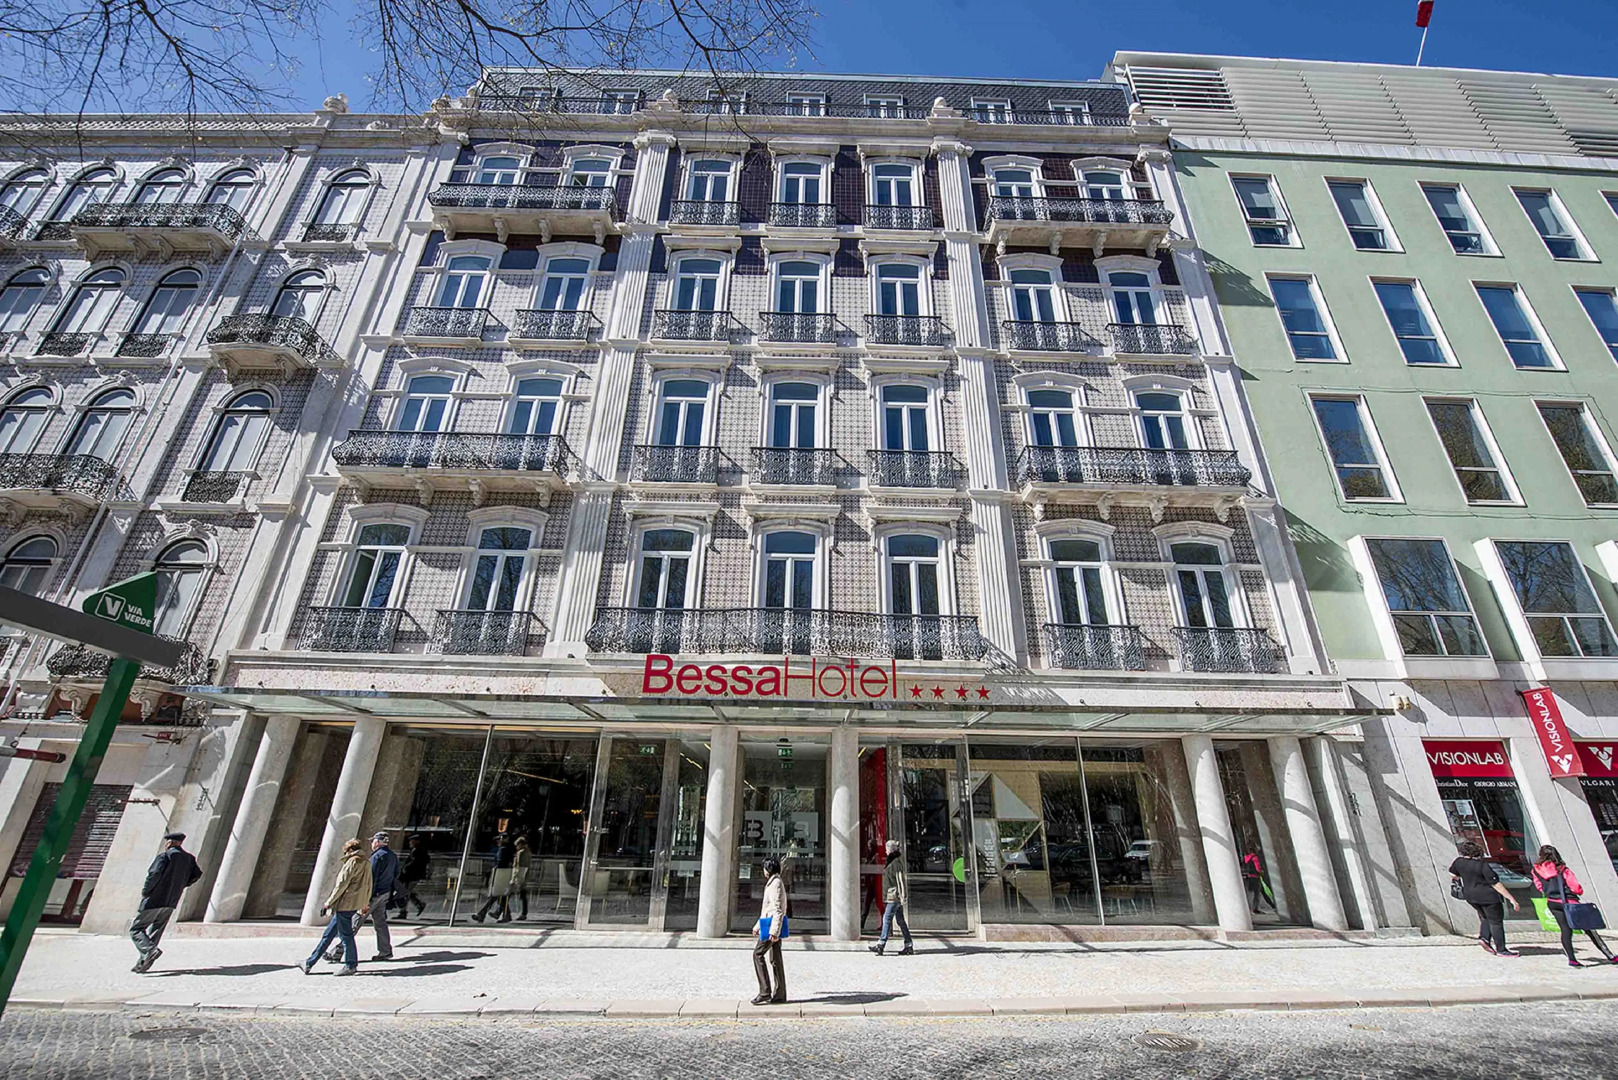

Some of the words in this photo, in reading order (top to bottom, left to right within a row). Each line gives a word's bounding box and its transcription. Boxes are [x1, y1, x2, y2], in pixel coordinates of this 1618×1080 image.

[128, 604, 142, 616] VIA
[124, 612, 152, 627] VERDE
[1532, 692, 1564, 753] VISIONLAB
[1427, 752, 1505, 765] VISIONLAB
